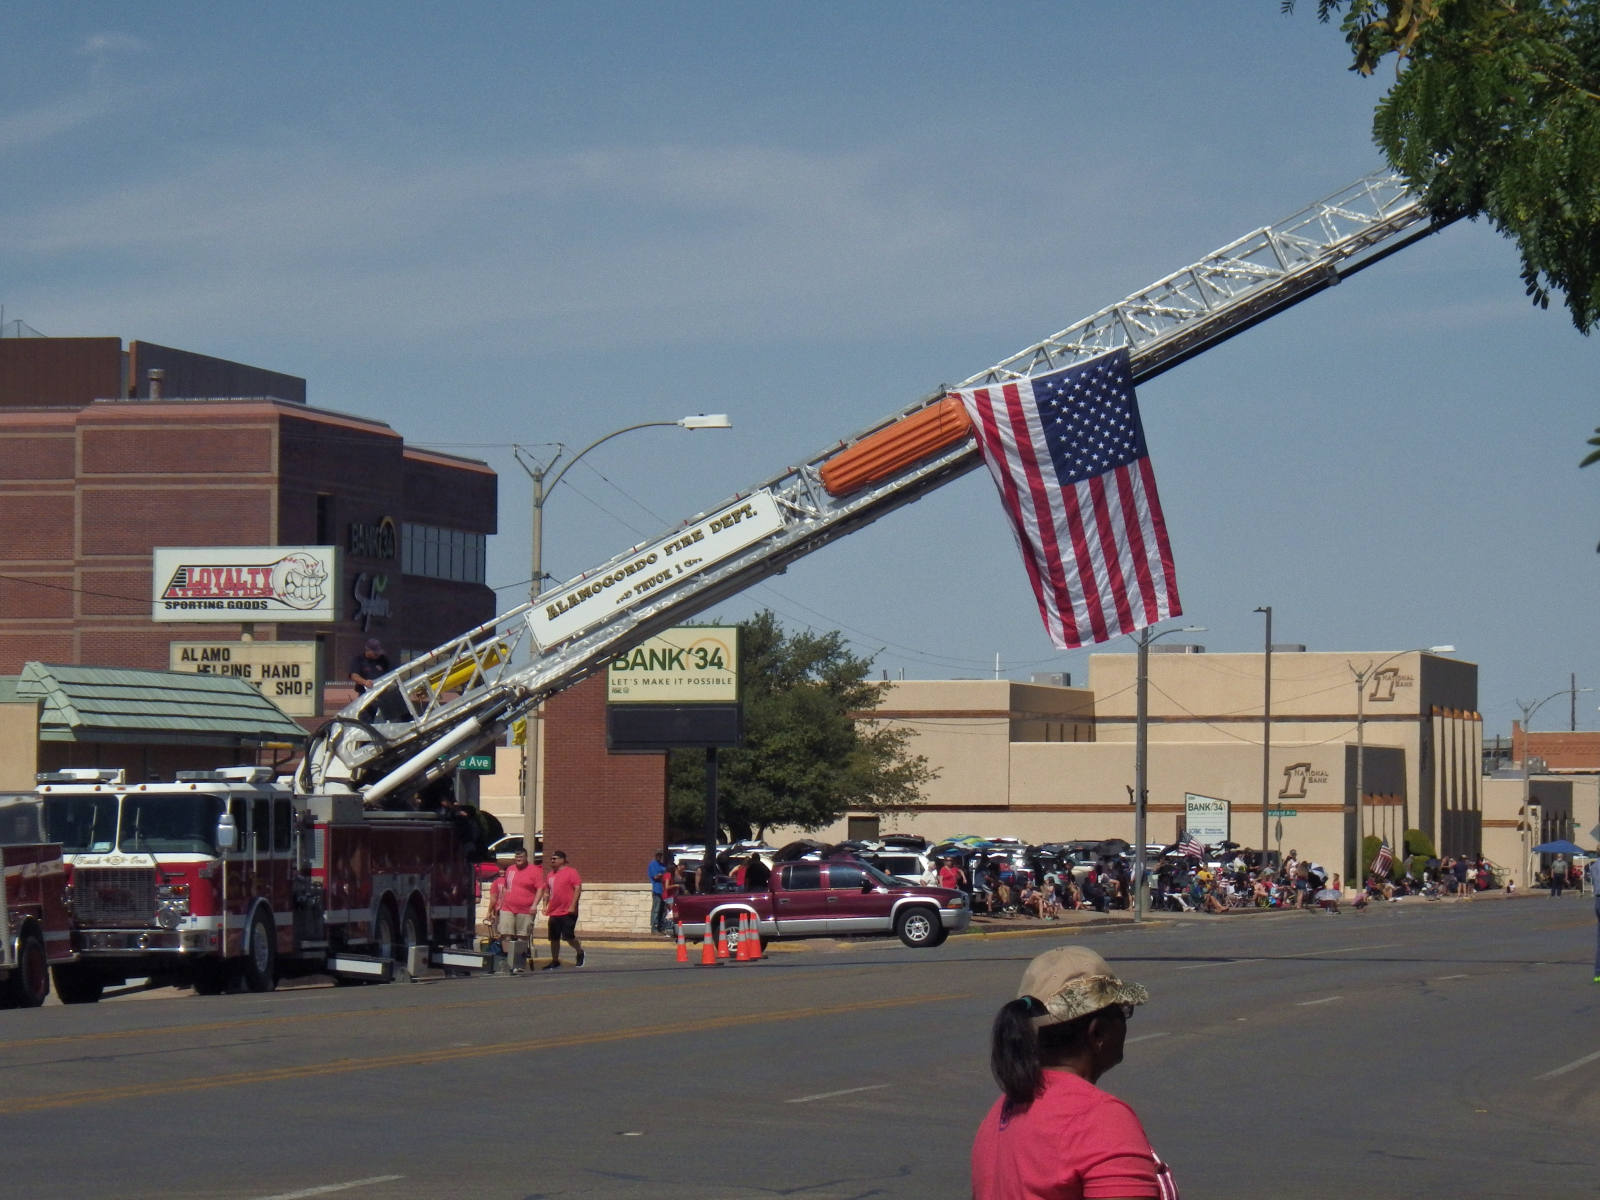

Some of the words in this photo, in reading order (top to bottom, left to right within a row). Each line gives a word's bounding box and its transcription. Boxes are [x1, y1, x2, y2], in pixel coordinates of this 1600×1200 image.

[545, 552, 658, 621] ALAMOGORDO
[663, 528, 705, 556] FIRE
[708, 503, 758, 534] DEPT.
[186, 567, 273, 588] LOYALTY
[633, 571, 673, 595] TRUCK
[675, 563, 683, 574] 1
[164, 600, 224, 610] SPORTING
[227, 600, 268, 610] GOODS
[181, 647, 231, 662] ALAMO
[262, 664, 300, 678] HAND
[275, 681, 313, 695] SHOP
[612, 678, 638, 686] LET'S
[642, 678, 670, 686] MAKE
[687, 677, 733, 685] POSSIBLE
[469, 757, 489, 767] Ave
